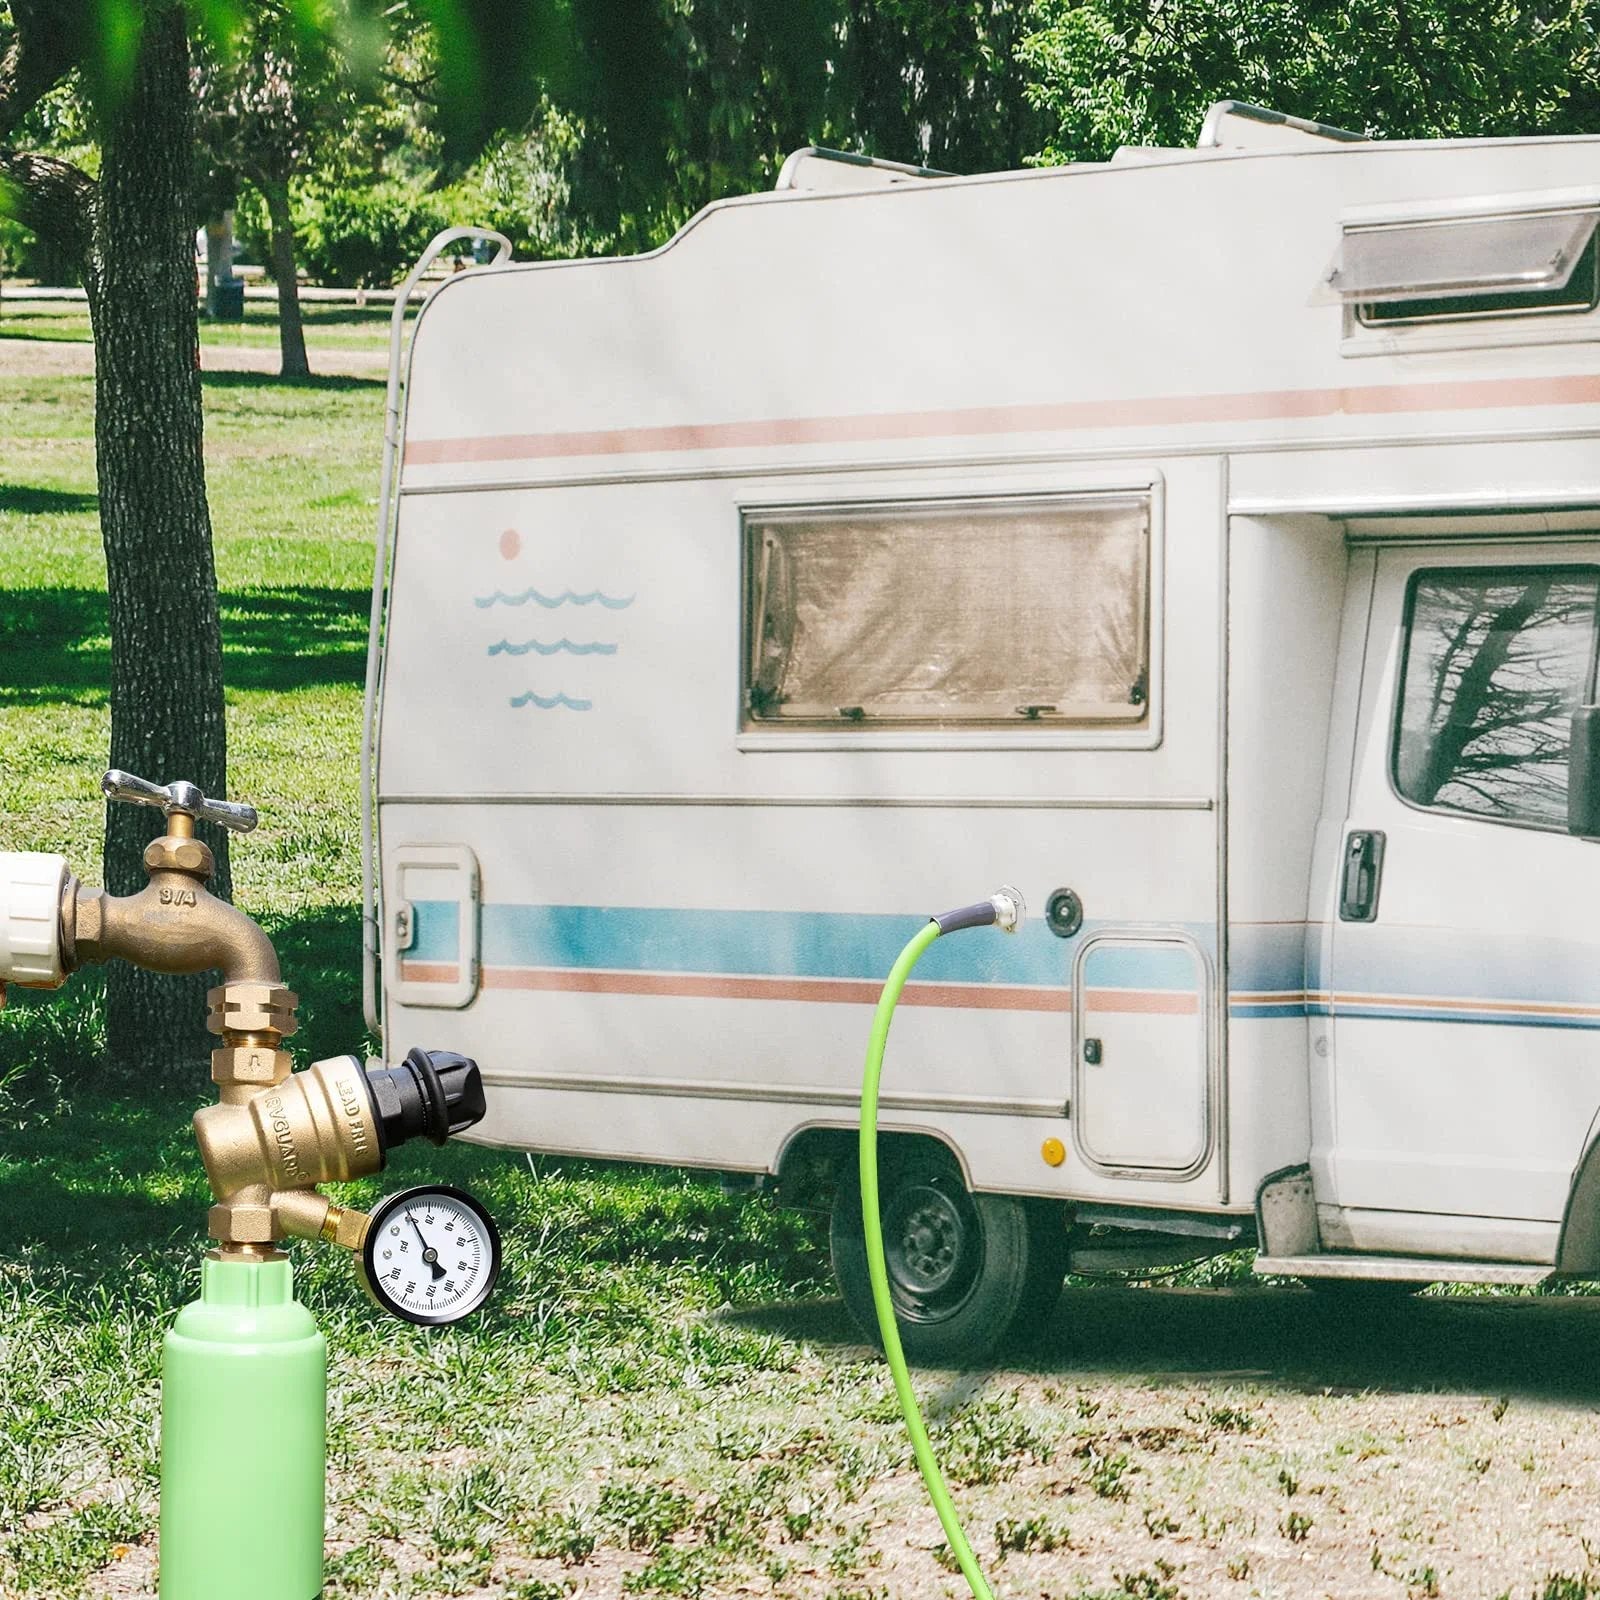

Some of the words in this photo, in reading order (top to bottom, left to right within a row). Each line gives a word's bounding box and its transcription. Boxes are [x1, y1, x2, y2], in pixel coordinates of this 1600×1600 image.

[159, 888, 197, 908] 3/4
[424, 1214, 435, 1225] 20
[444, 1221, 455, 1232] 40
[399, 1240, 409, 1253] psi
[456, 1236, 467, 1248] 60
[457, 1260, 468, 1272] 80
[390, 1267, 402, 1280] 160
[405, 1280, 417, 1294] 140
[425, 1284, 437, 1298] 120
[443, 1279, 455, 1293] 100
